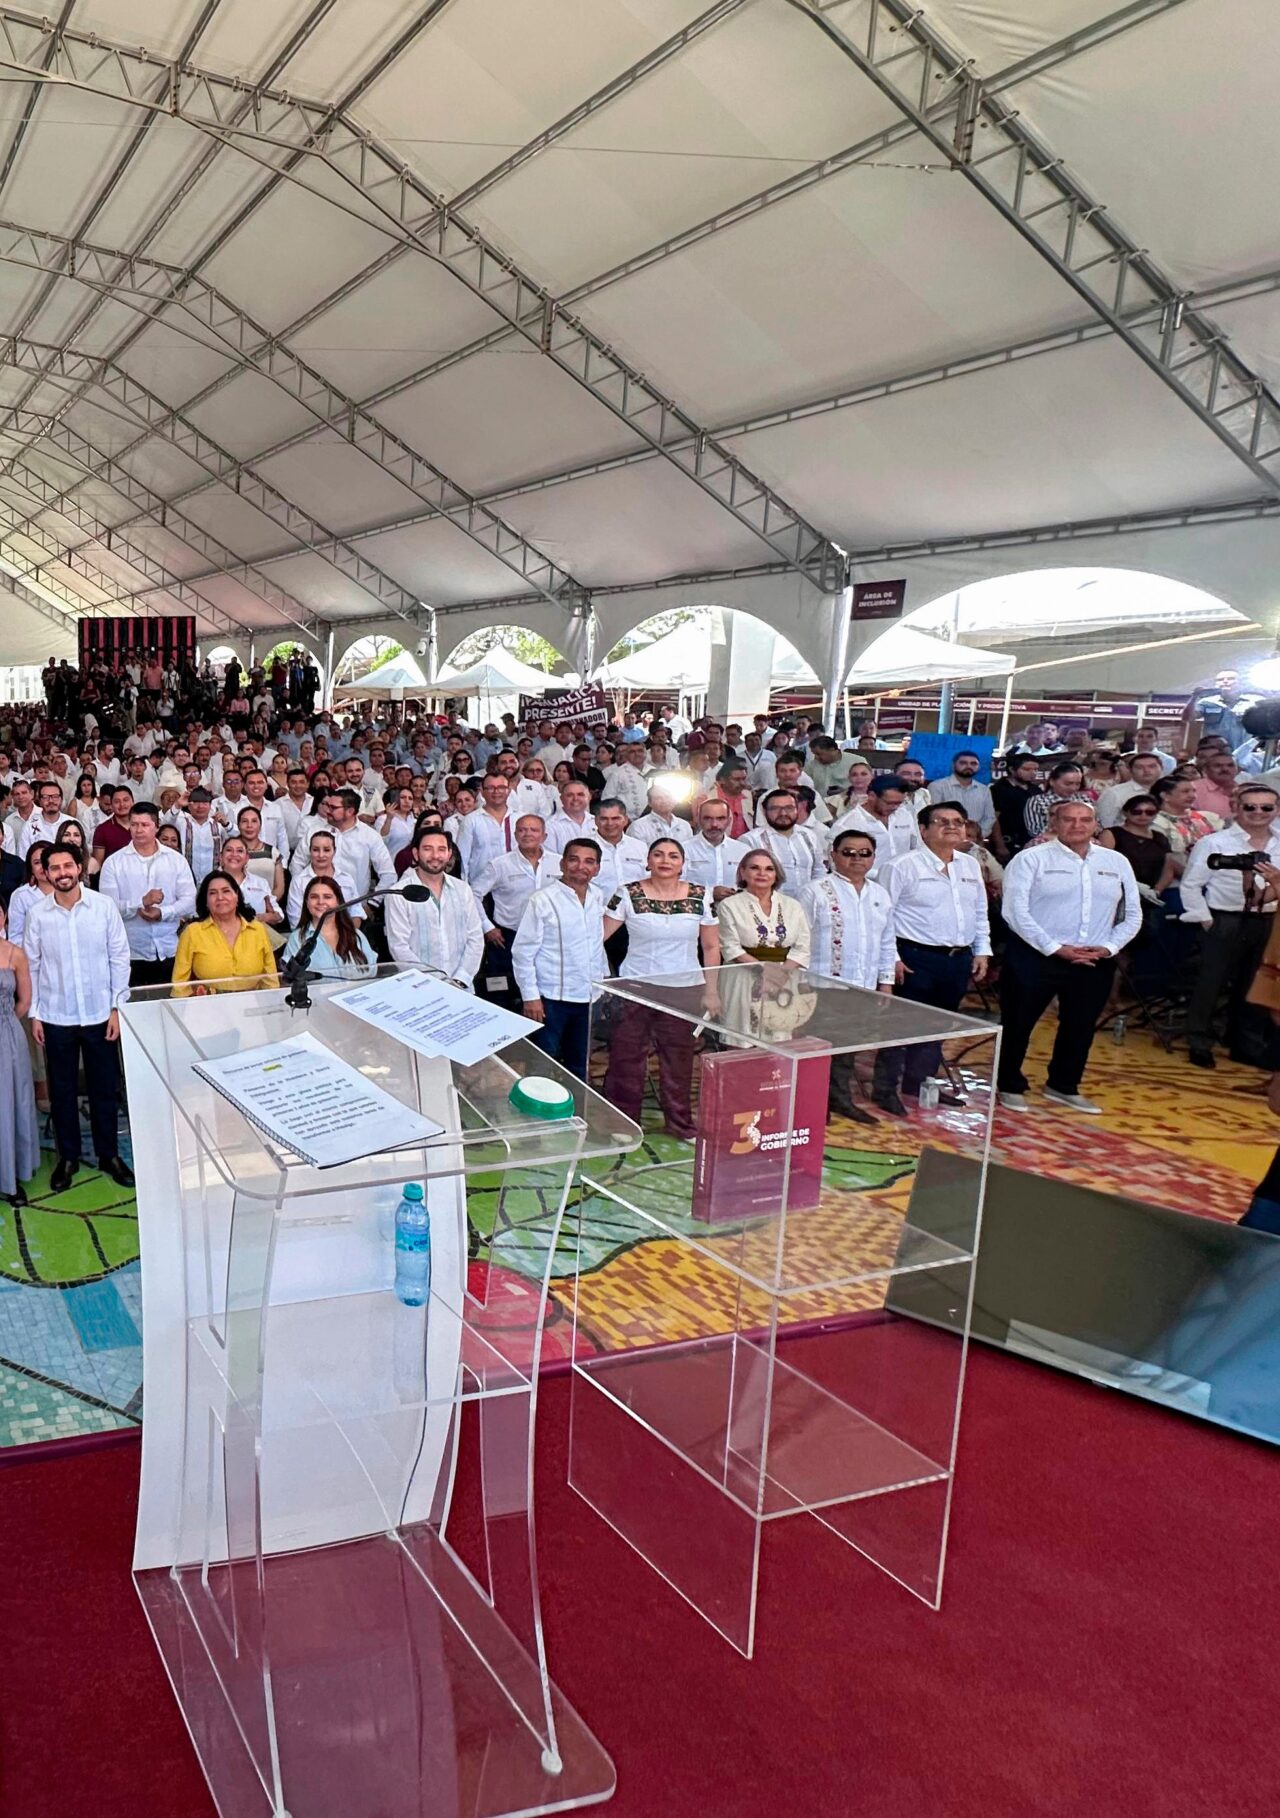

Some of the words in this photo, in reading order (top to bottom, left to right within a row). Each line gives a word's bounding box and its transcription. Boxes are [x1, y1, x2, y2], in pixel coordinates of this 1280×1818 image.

[863, 592, 882, 600] ÁREA
[858, 599, 897, 607] INCLUSIÓN
[524, 695, 598, 721] PRESENTE!
[799, 1128, 810, 1137] DE
[760, 1136, 810, 1151] GOBIERNO
